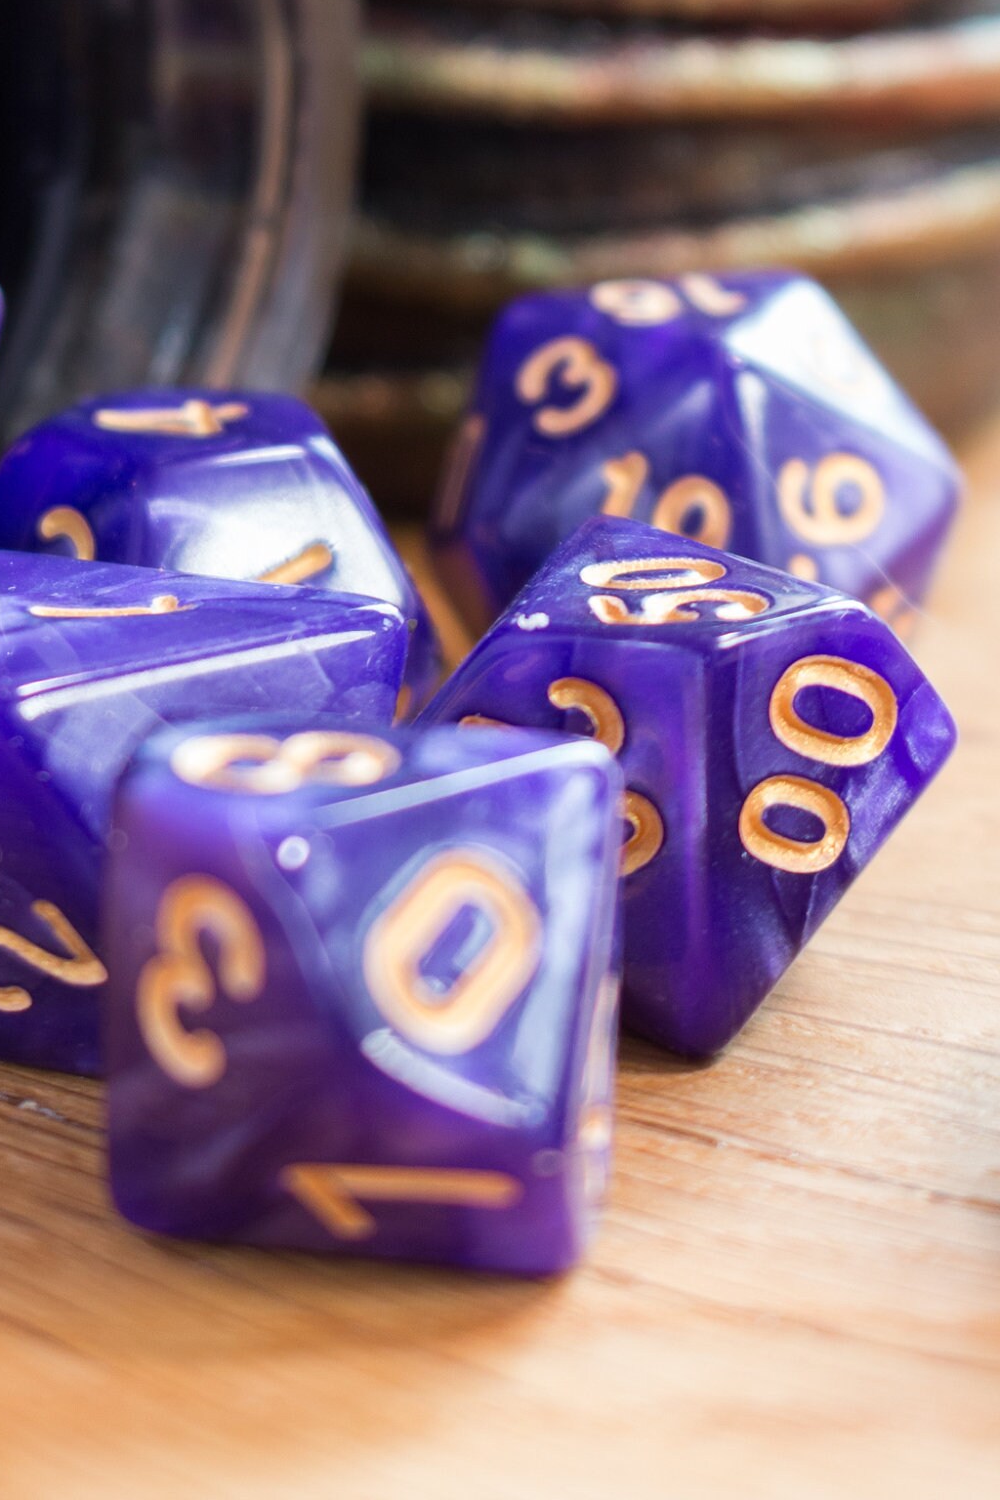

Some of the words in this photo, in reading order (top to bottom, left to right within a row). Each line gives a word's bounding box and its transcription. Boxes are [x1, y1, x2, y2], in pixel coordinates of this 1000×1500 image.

[515, 336, 618, 437] 3
[580, 557, 773, 625] 50
[172, 730, 401, 794] 8
[738, 654, 898, 874] 00
[136, 873, 267, 1088] 3
[365, 846, 542, 1055] 0
[281, 1162, 523, 1239] 1
